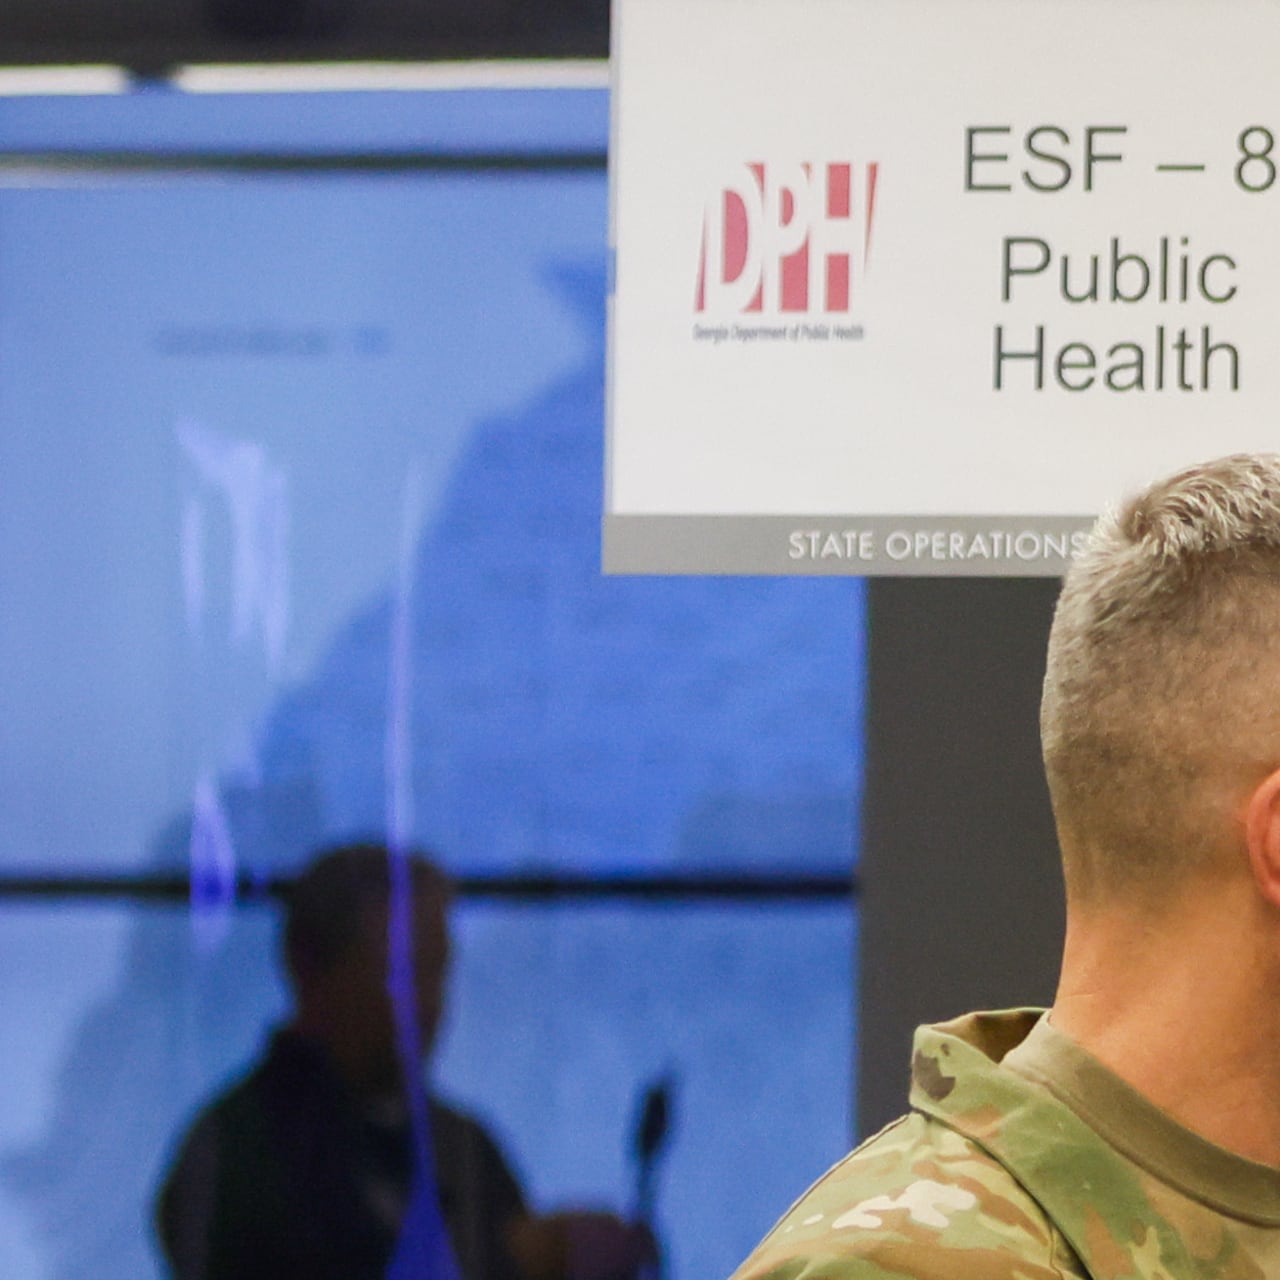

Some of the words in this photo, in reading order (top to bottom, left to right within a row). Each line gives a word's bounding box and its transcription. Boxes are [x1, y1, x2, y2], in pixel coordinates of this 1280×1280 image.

[965, 125, 1128, 192] ESF
[1234, 125, 1277, 192] 8
[696, 161, 879, 313] DPH
[1001, 235, 1238, 303] Public
[992, 324, 1240, 391] Health
[788, 530, 874, 560] STATE
